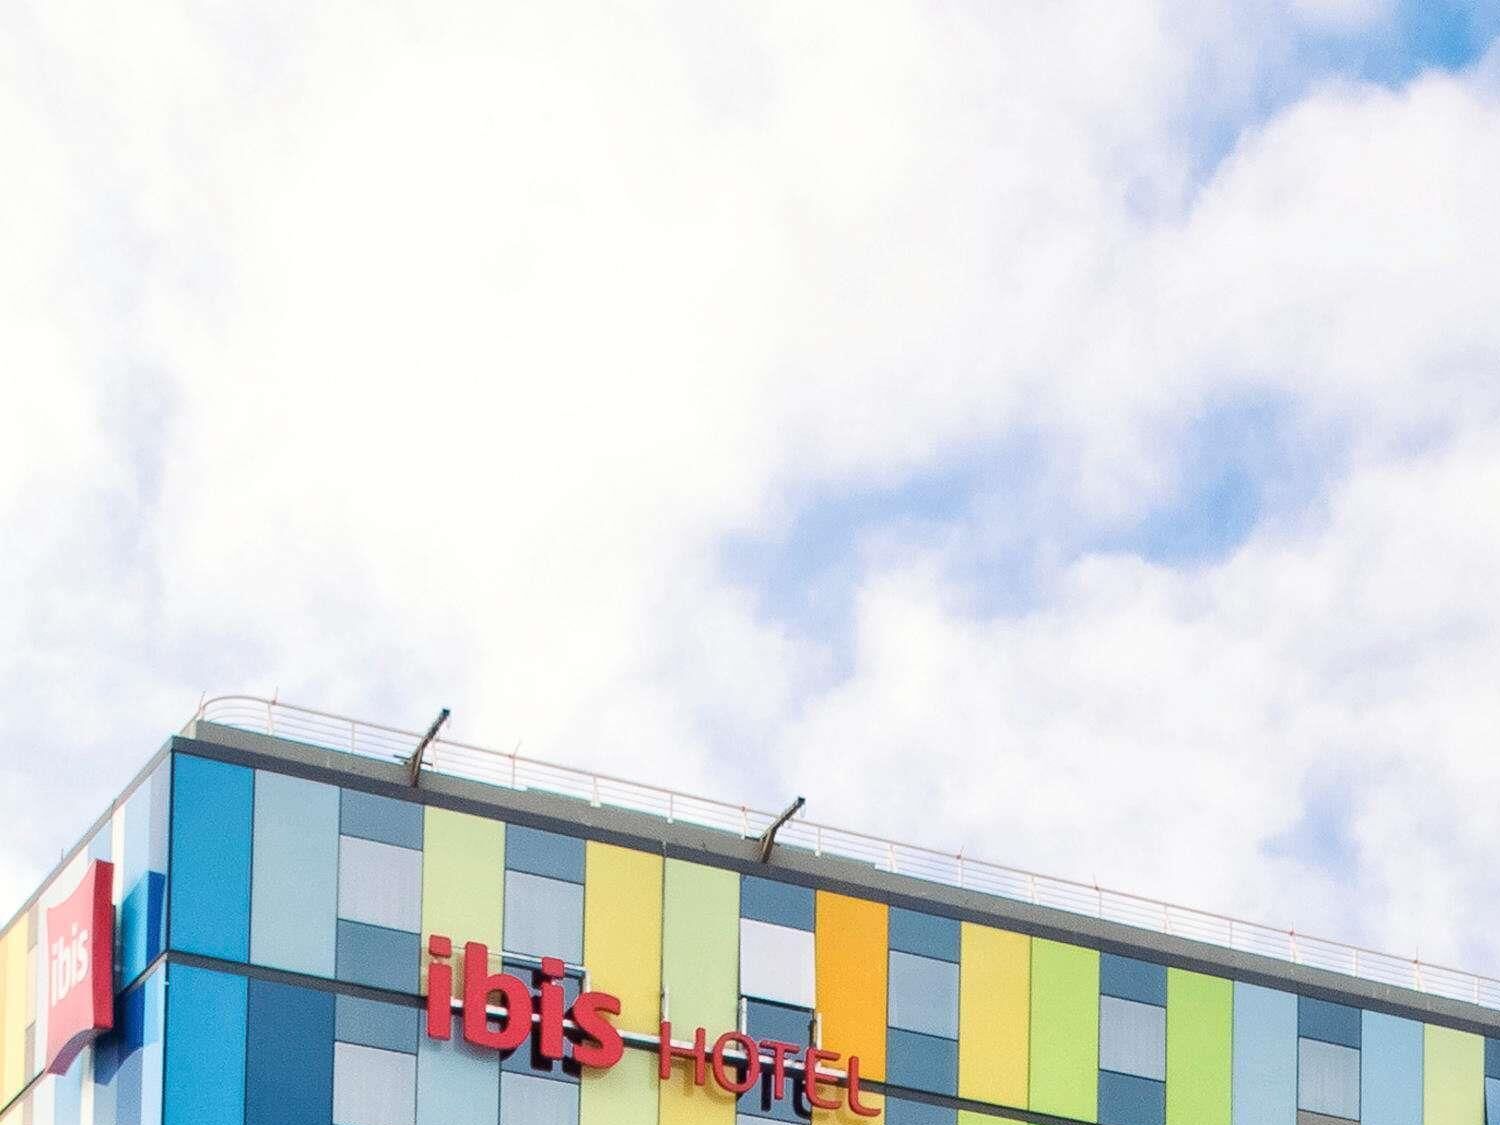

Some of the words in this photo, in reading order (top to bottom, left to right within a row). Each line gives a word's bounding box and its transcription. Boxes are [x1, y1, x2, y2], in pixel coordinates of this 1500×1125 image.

[50, 922, 90, 1008] ibis
[427, 935, 624, 1070] ibis
[658, 1019, 882, 1118] HOTEL
